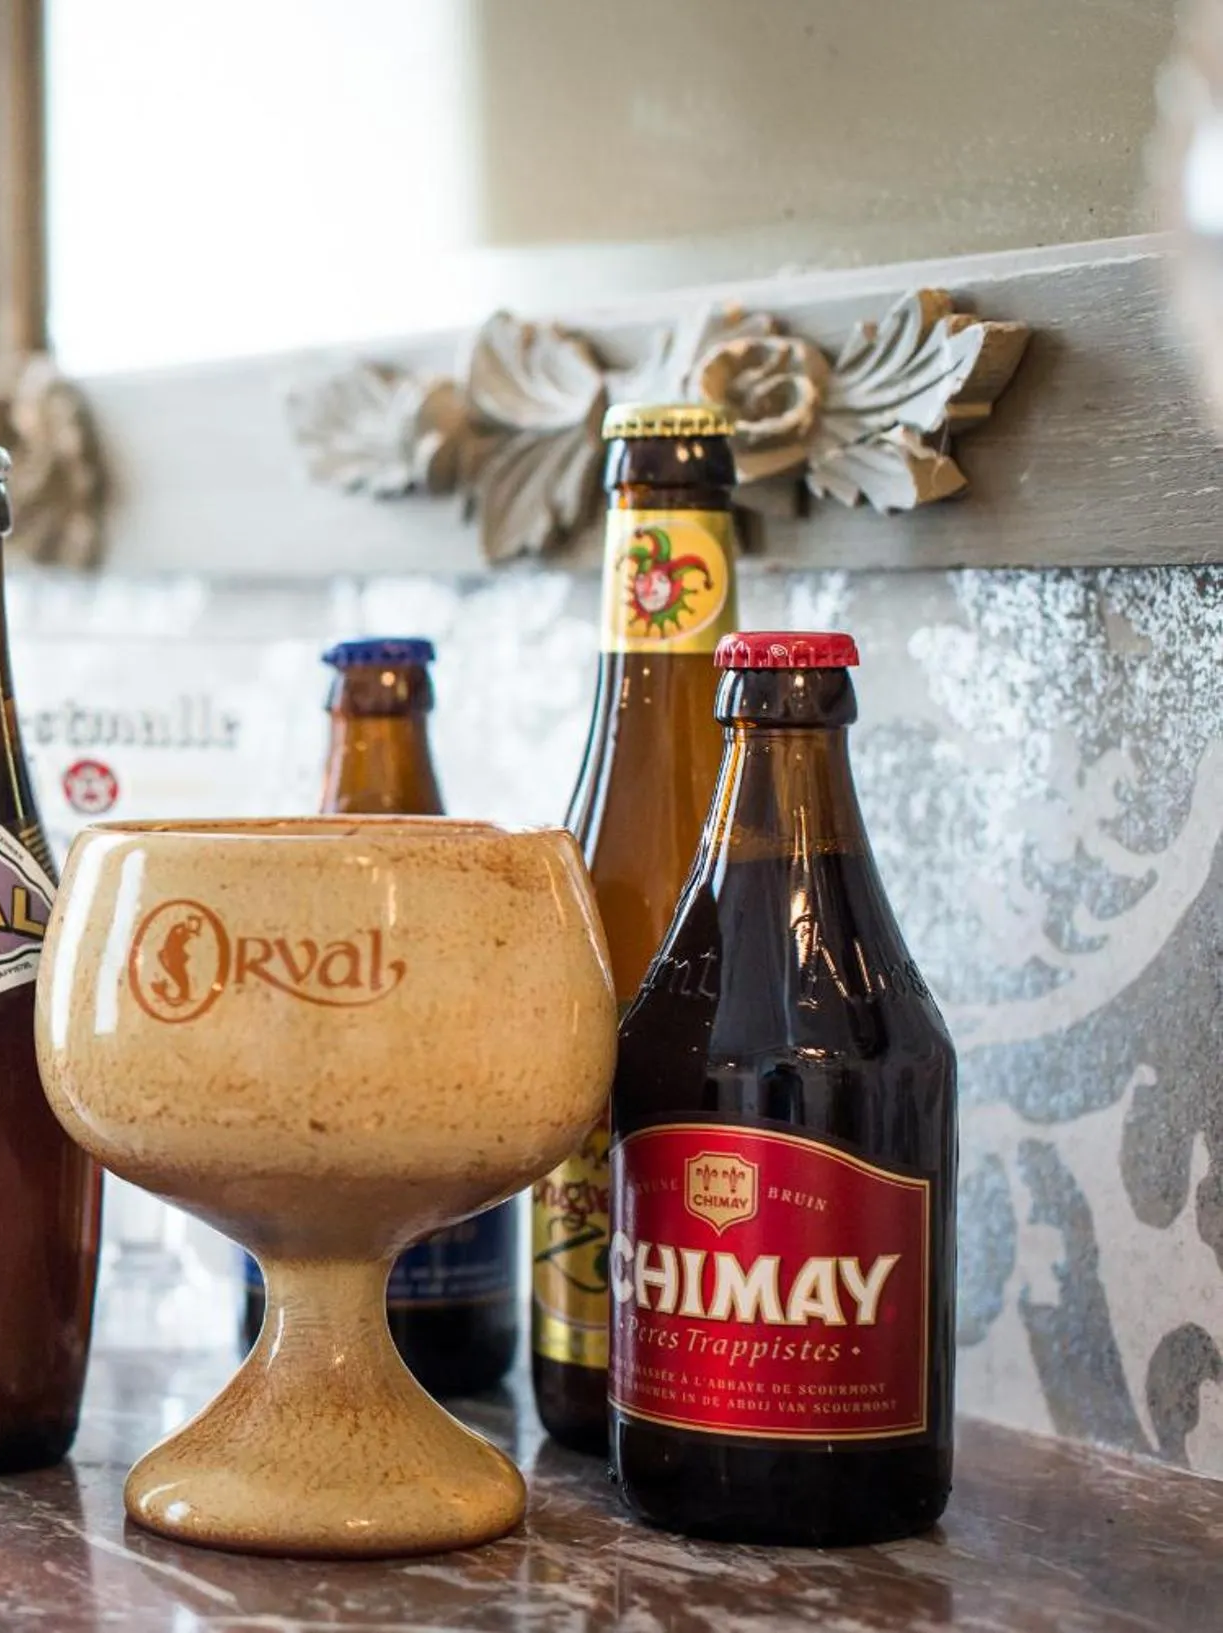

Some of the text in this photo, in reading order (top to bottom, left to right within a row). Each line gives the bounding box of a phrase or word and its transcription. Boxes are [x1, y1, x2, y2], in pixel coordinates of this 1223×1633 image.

[693, 1194, 748, 1210] CHIMAY
[767, 1187, 828, 1212] BRUIN
[610, 1230, 902, 1326] CHIMAY
[687, 1328, 841, 1369] Trappistes
[772, 1383, 792, 1394] DE
[703, 1395, 720, 1407] DE
[779, 1401, 807, 1413] VAN
